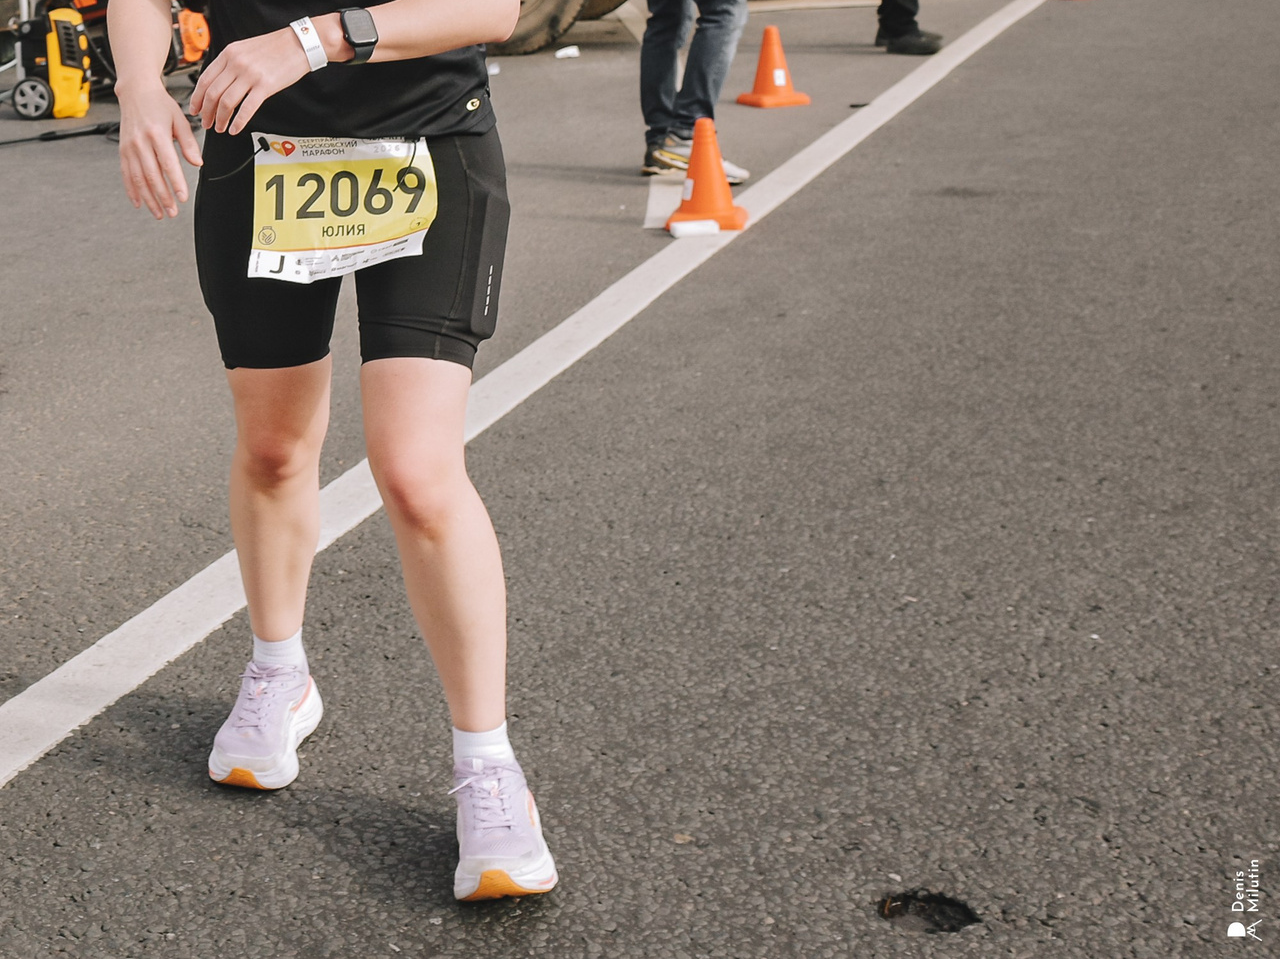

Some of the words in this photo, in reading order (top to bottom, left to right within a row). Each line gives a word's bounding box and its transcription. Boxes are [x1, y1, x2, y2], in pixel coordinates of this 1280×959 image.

[299, 139, 358, 149] МОСКОВСКИЙ
[302, 148, 345, 157] МАРАФОН
[265, 166, 426, 221] 12069
[322, 224, 365, 237] ЮЛИЯ
[269, 255, 286, 274] J
